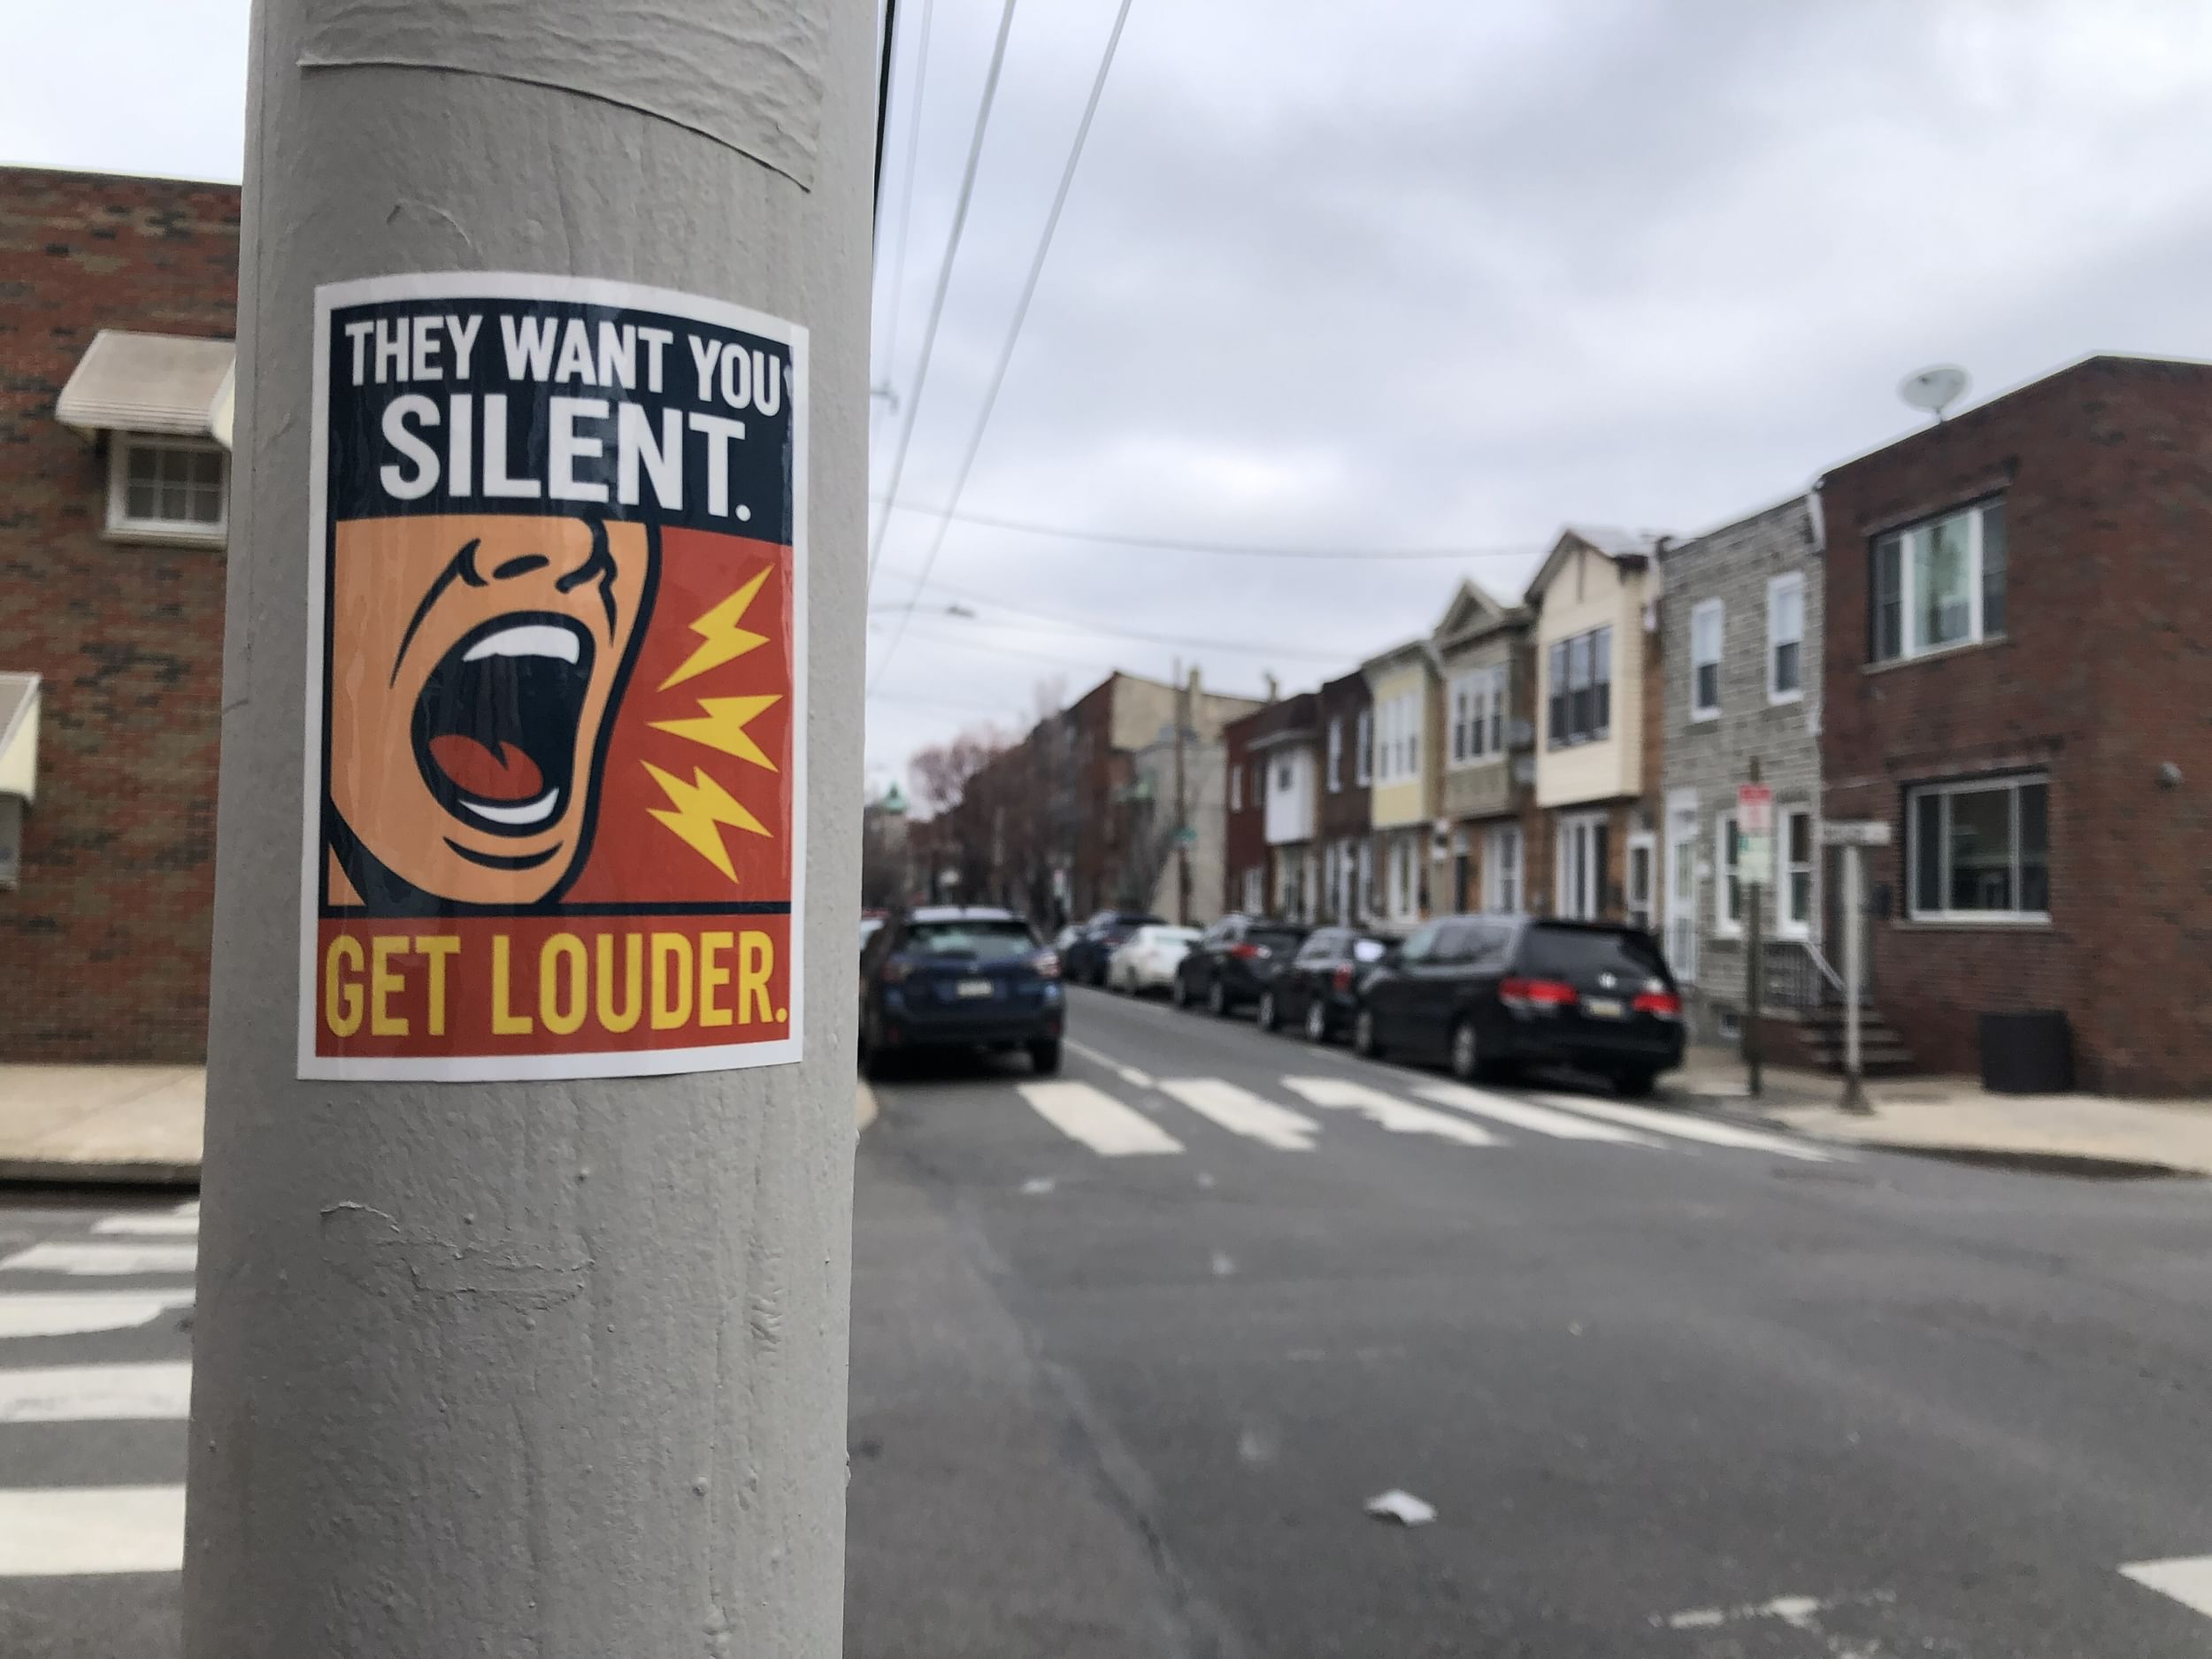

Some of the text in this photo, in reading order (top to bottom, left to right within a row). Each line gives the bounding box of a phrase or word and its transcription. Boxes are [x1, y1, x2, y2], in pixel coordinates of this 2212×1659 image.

[345, 315, 781, 418] THEY WANT YOU
[380, 392, 752, 522] SILENT.
[325, 930, 788, 1039] GET LOUDER.
